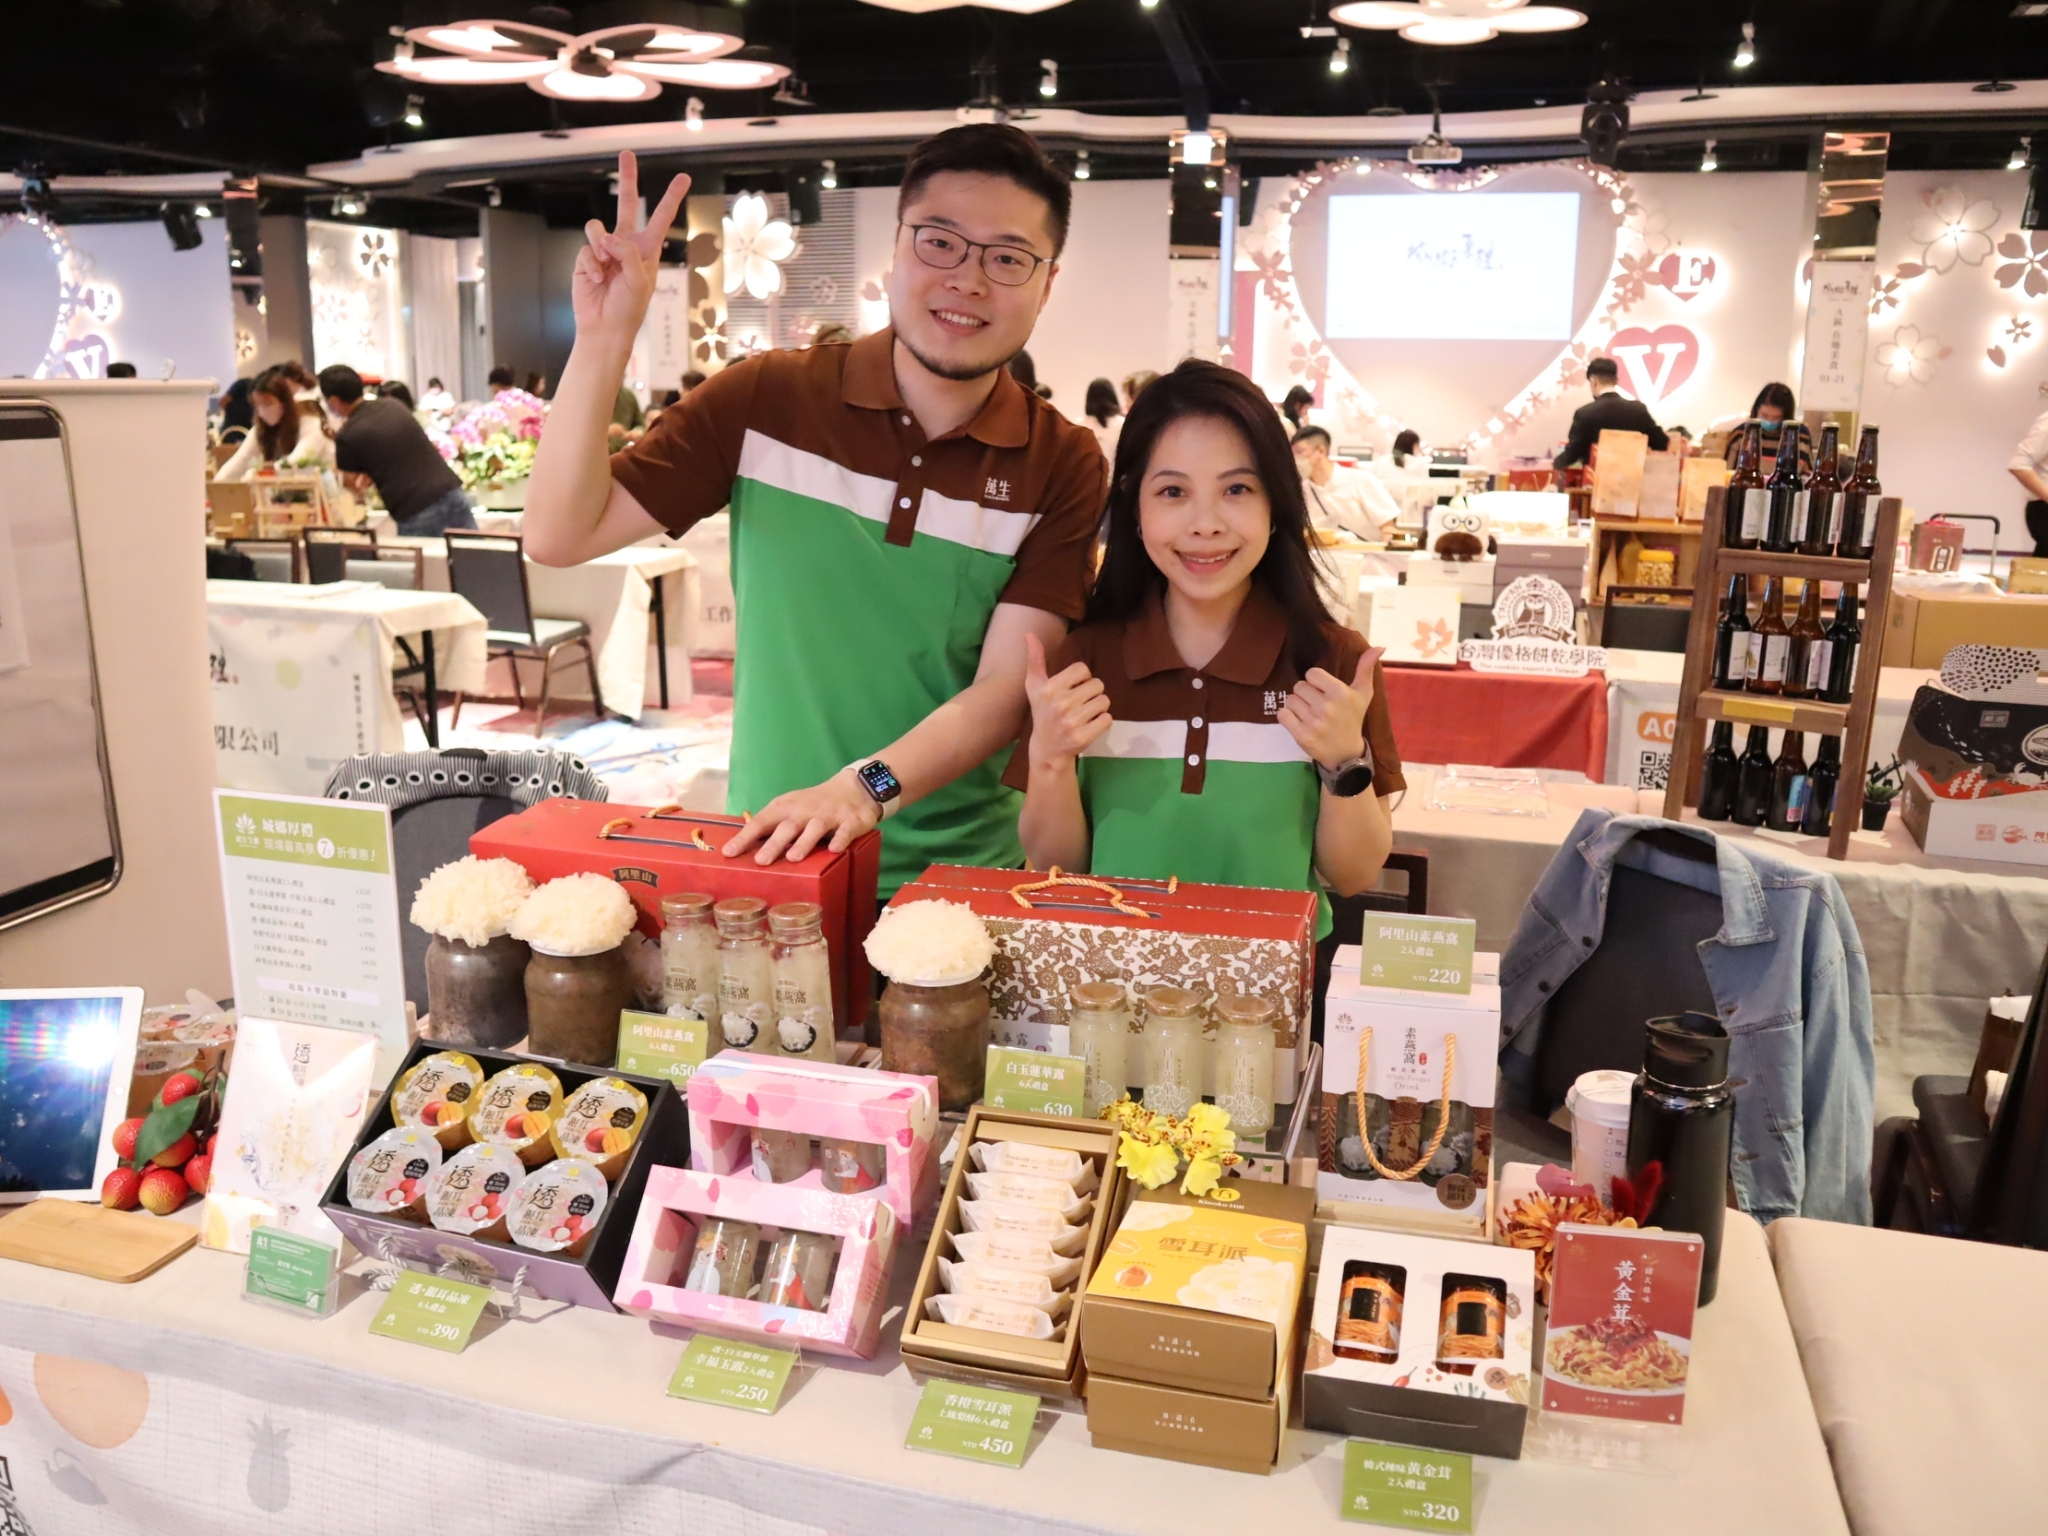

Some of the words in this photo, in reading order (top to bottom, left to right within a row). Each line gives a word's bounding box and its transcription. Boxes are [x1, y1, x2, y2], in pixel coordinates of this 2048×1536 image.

[1612, 342, 1686, 402] V
[985, 477, 1011, 497] 萬生
[1460, 642, 1608, 668] 台灣優格餅乾學院
[619, 869, 652, 883] 阿里山
[1379, 927, 1459, 946] 阿里山素燕窩
[1412, 974, 1427, 982] NTD
[1429, 968, 1461, 985] 220
[633, 1025, 694, 1043] 阿里山素燕窩
[293, 1042, 311, 1064] 透
[1403, 1027, 1416, 1065] 素燕窩
[415, 1068, 444, 1092] 透
[671, 1064, 695, 1077] 650
[1006, 1062, 1066, 1080] 白玉蓮華露
[1395, 1082, 1420, 1091] Drink
[487, 1086, 516, 1108] 透
[571, 1093, 604, 1118] 透
[1044, 1102, 1073, 1117] 630
[367, 1149, 397, 1173] 透
[446, 1165, 475, 1190] 透
[528, 1183, 559, 1210] 透
[1198, 1199, 1228, 1208] Kinoko
[1158, 1236, 1249, 1262] 雪耳派
[1611, 1260, 1637, 1325] 黃金茸
[430, 1323, 459, 1340] 390
[721, 1388, 734, 1396] NTD
[735, 1384, 768, 1402] 250
[944, 1394, 1013, 1416] 香橙雪耳派
[961, 1440, 977, 1449] NTD
[979, 1437, 1013, 1455] 450
[1403, 1508, 1420, 1517] NTD
[1421, 1502, 1460, 1522] 320
